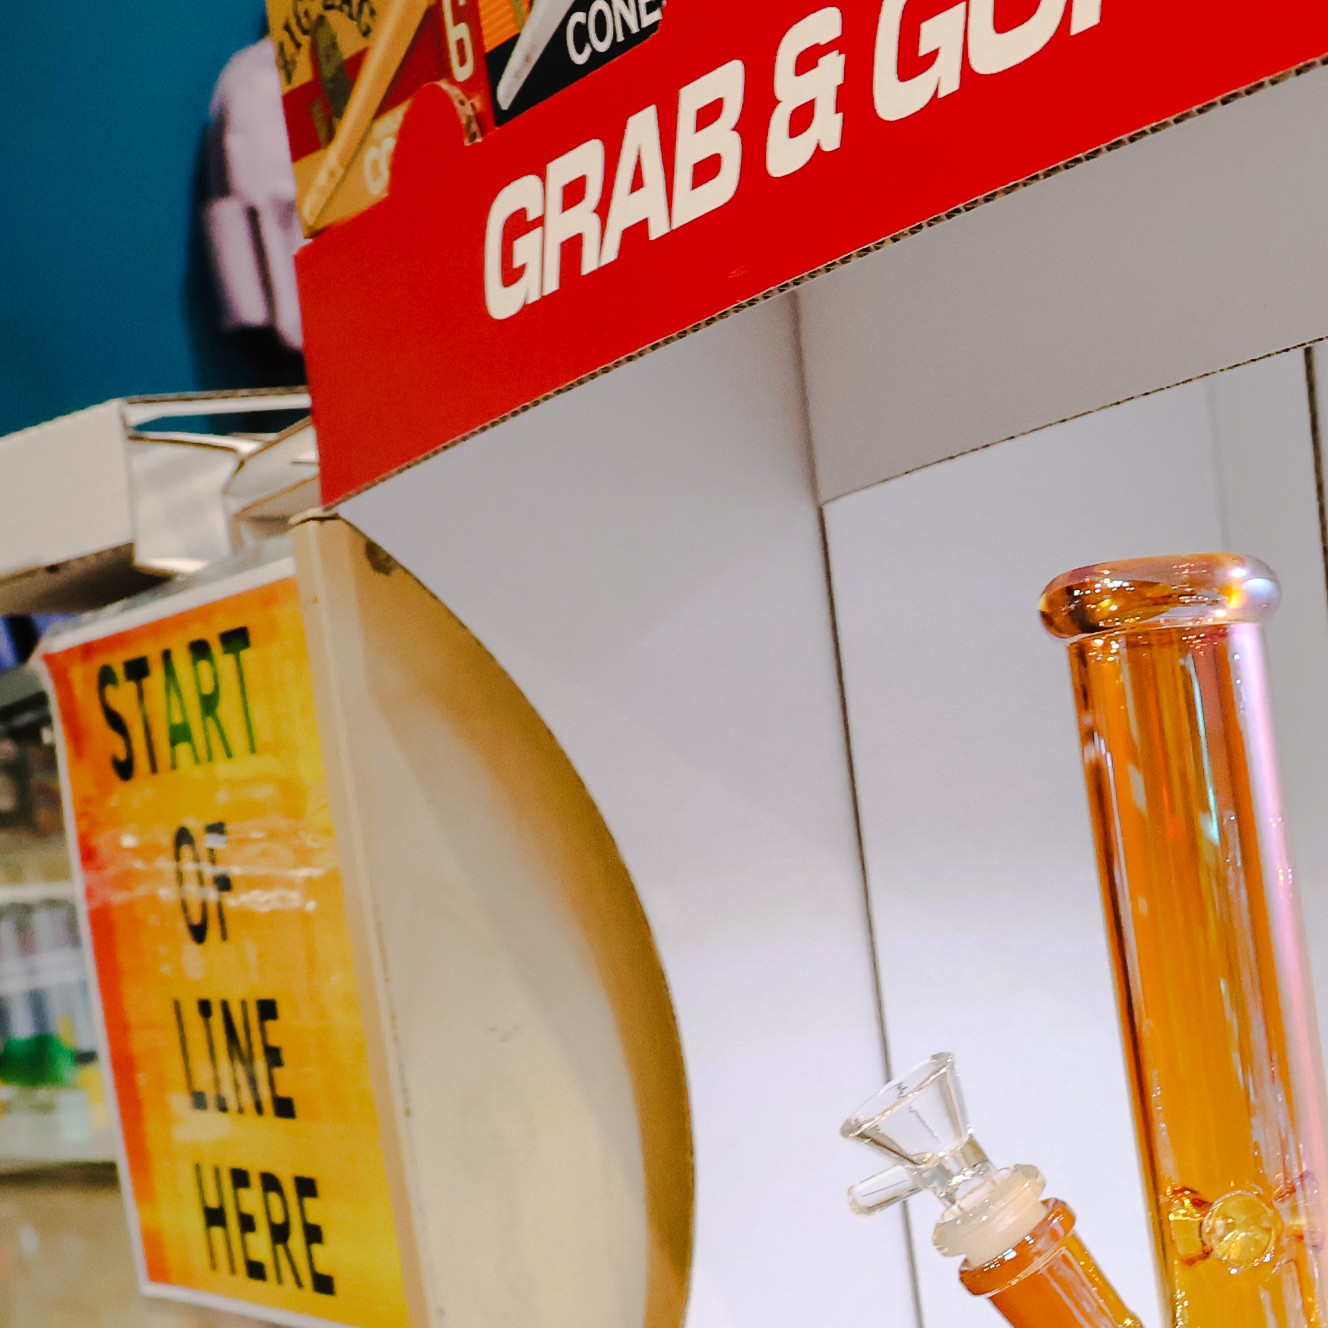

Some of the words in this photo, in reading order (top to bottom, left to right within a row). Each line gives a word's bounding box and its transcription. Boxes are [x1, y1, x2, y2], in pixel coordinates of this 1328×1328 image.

[484, 58, 746, 320] GRAB
[765, 6, 846, 178] &
[97, 624, 257, 782] START
[173, 820, 233, 945] OF
[173, 997, 297, 1121] LINE
[195, 1161, 337, 1297] HERE
